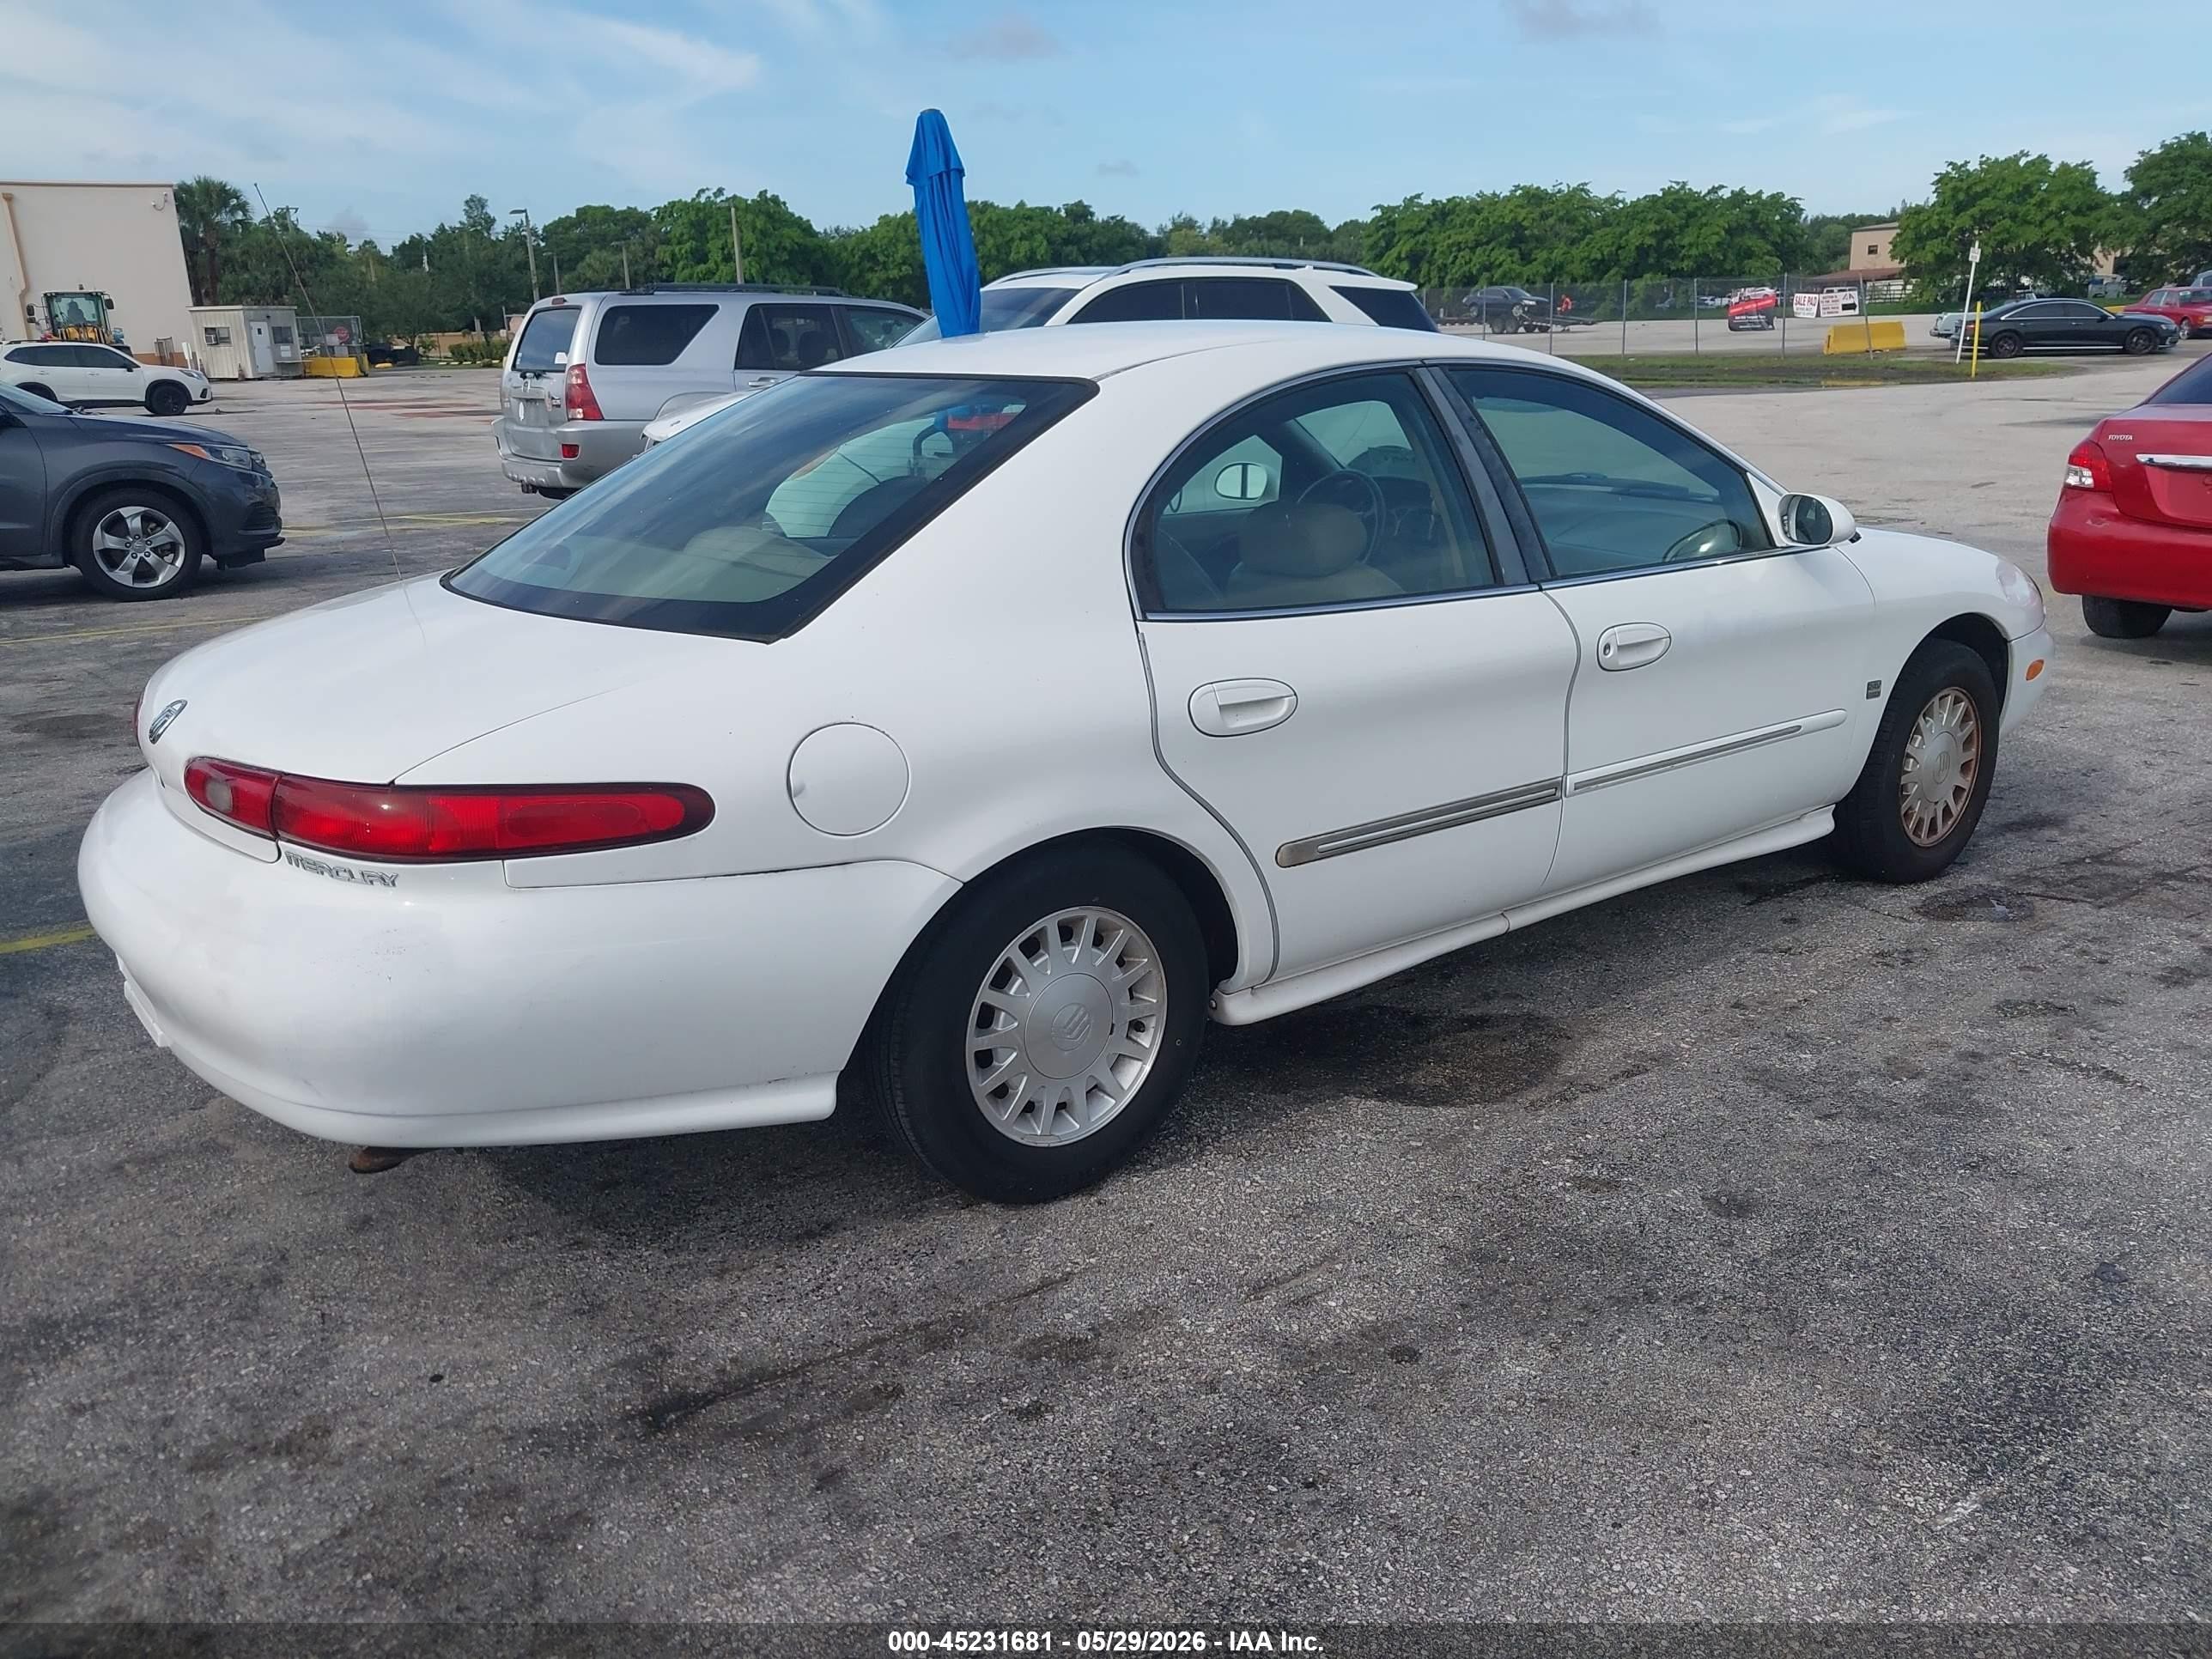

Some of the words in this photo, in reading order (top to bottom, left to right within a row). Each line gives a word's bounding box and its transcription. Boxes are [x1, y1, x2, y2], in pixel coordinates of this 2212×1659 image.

[1795, 295, 1806, 306] SALE
[1807, 296, 1817, 307] PAD
[284, 851, 399, 888] MERCURY
